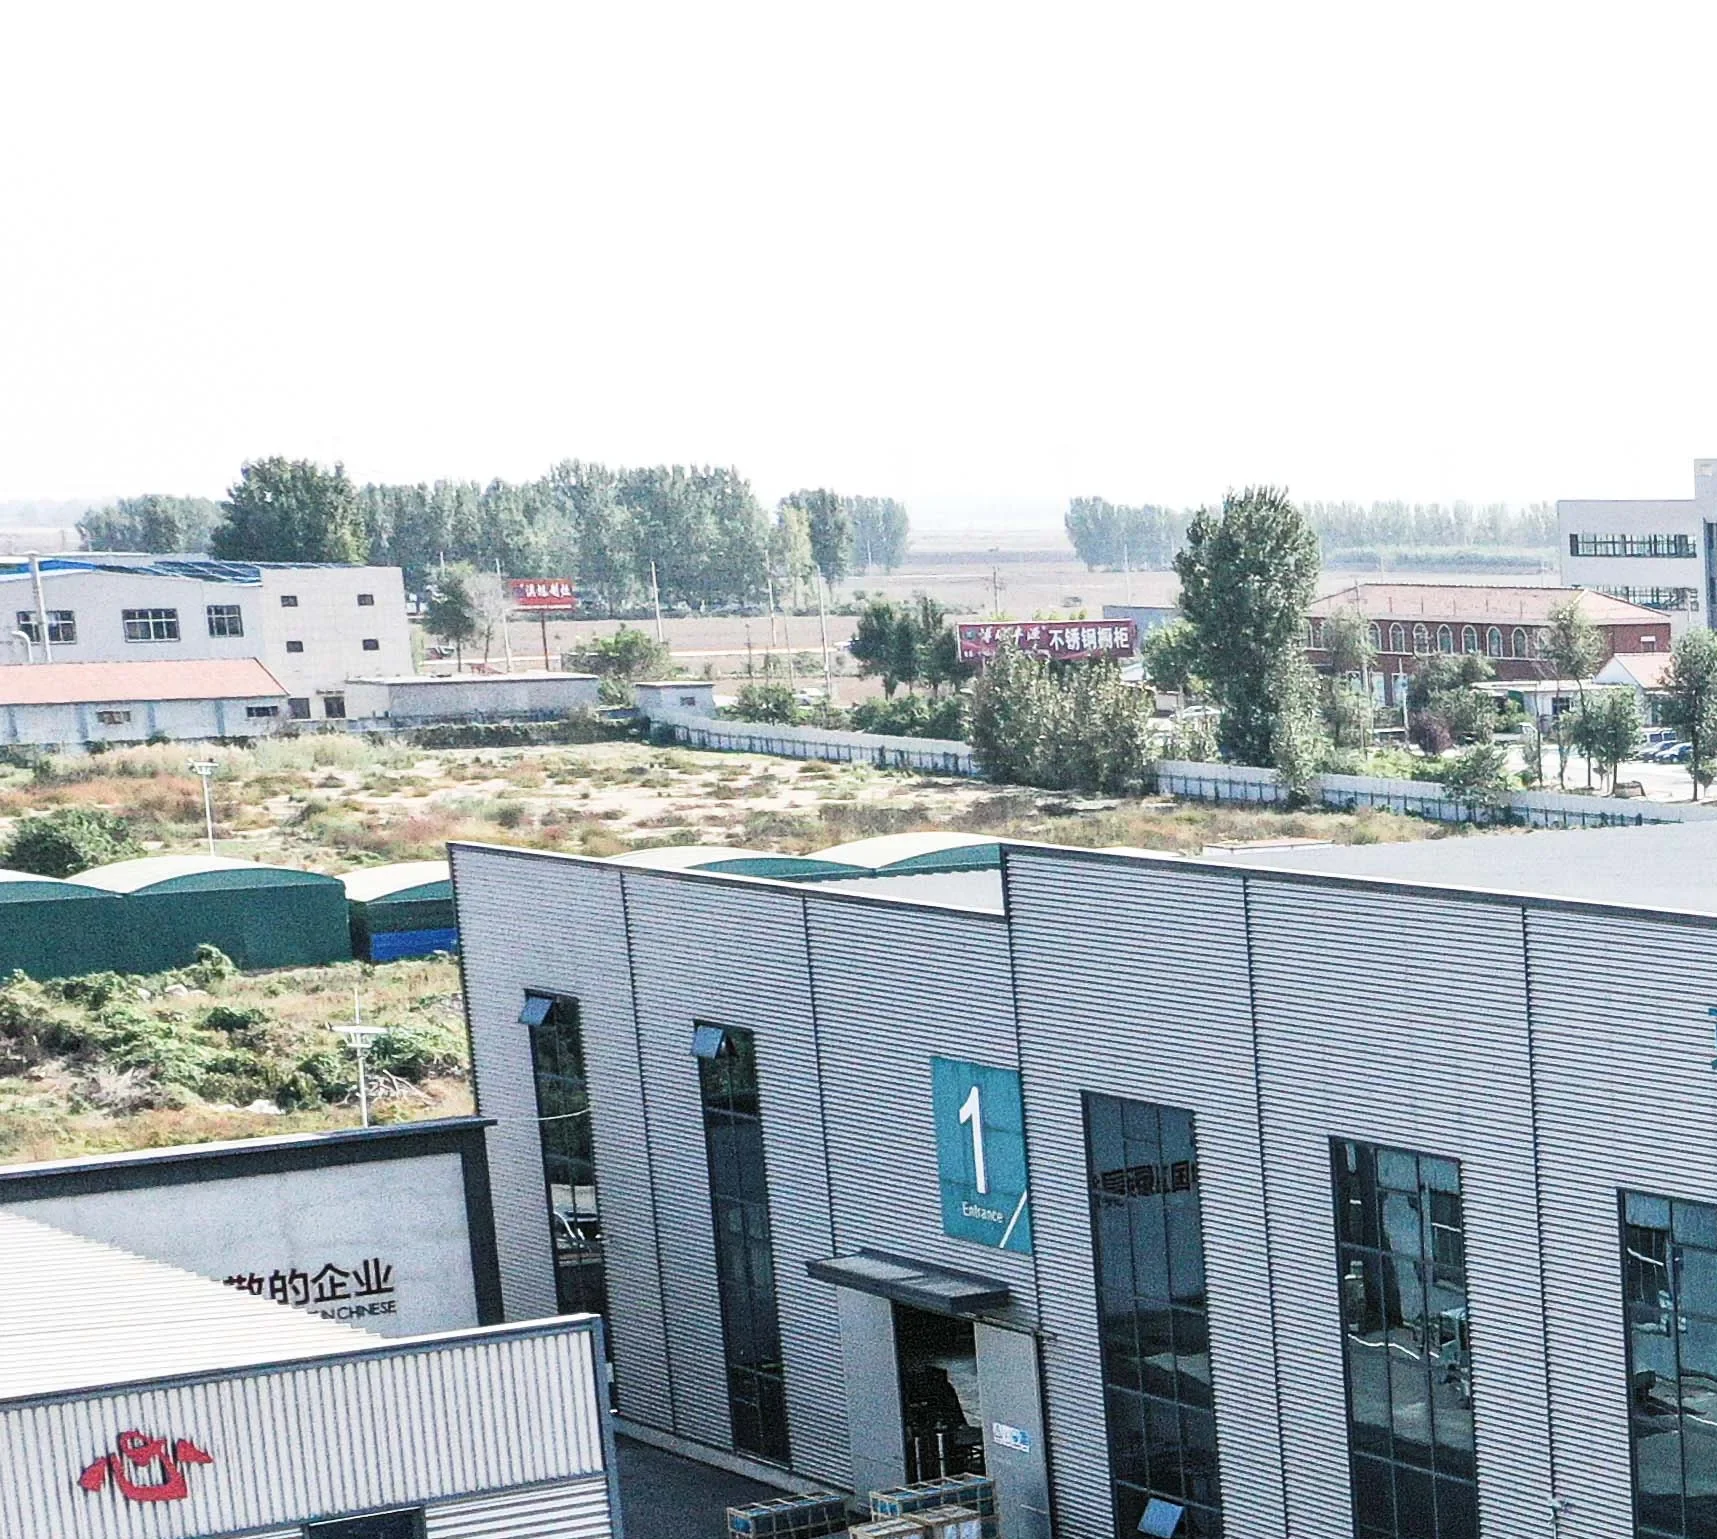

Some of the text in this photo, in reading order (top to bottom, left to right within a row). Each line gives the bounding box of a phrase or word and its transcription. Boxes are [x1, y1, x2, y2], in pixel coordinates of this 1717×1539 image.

[959, 1086, 987, 1194] 1
[962, 1201, 1005, 1223] Entrance
[337, 1300, 397, 1319] CHINESE
